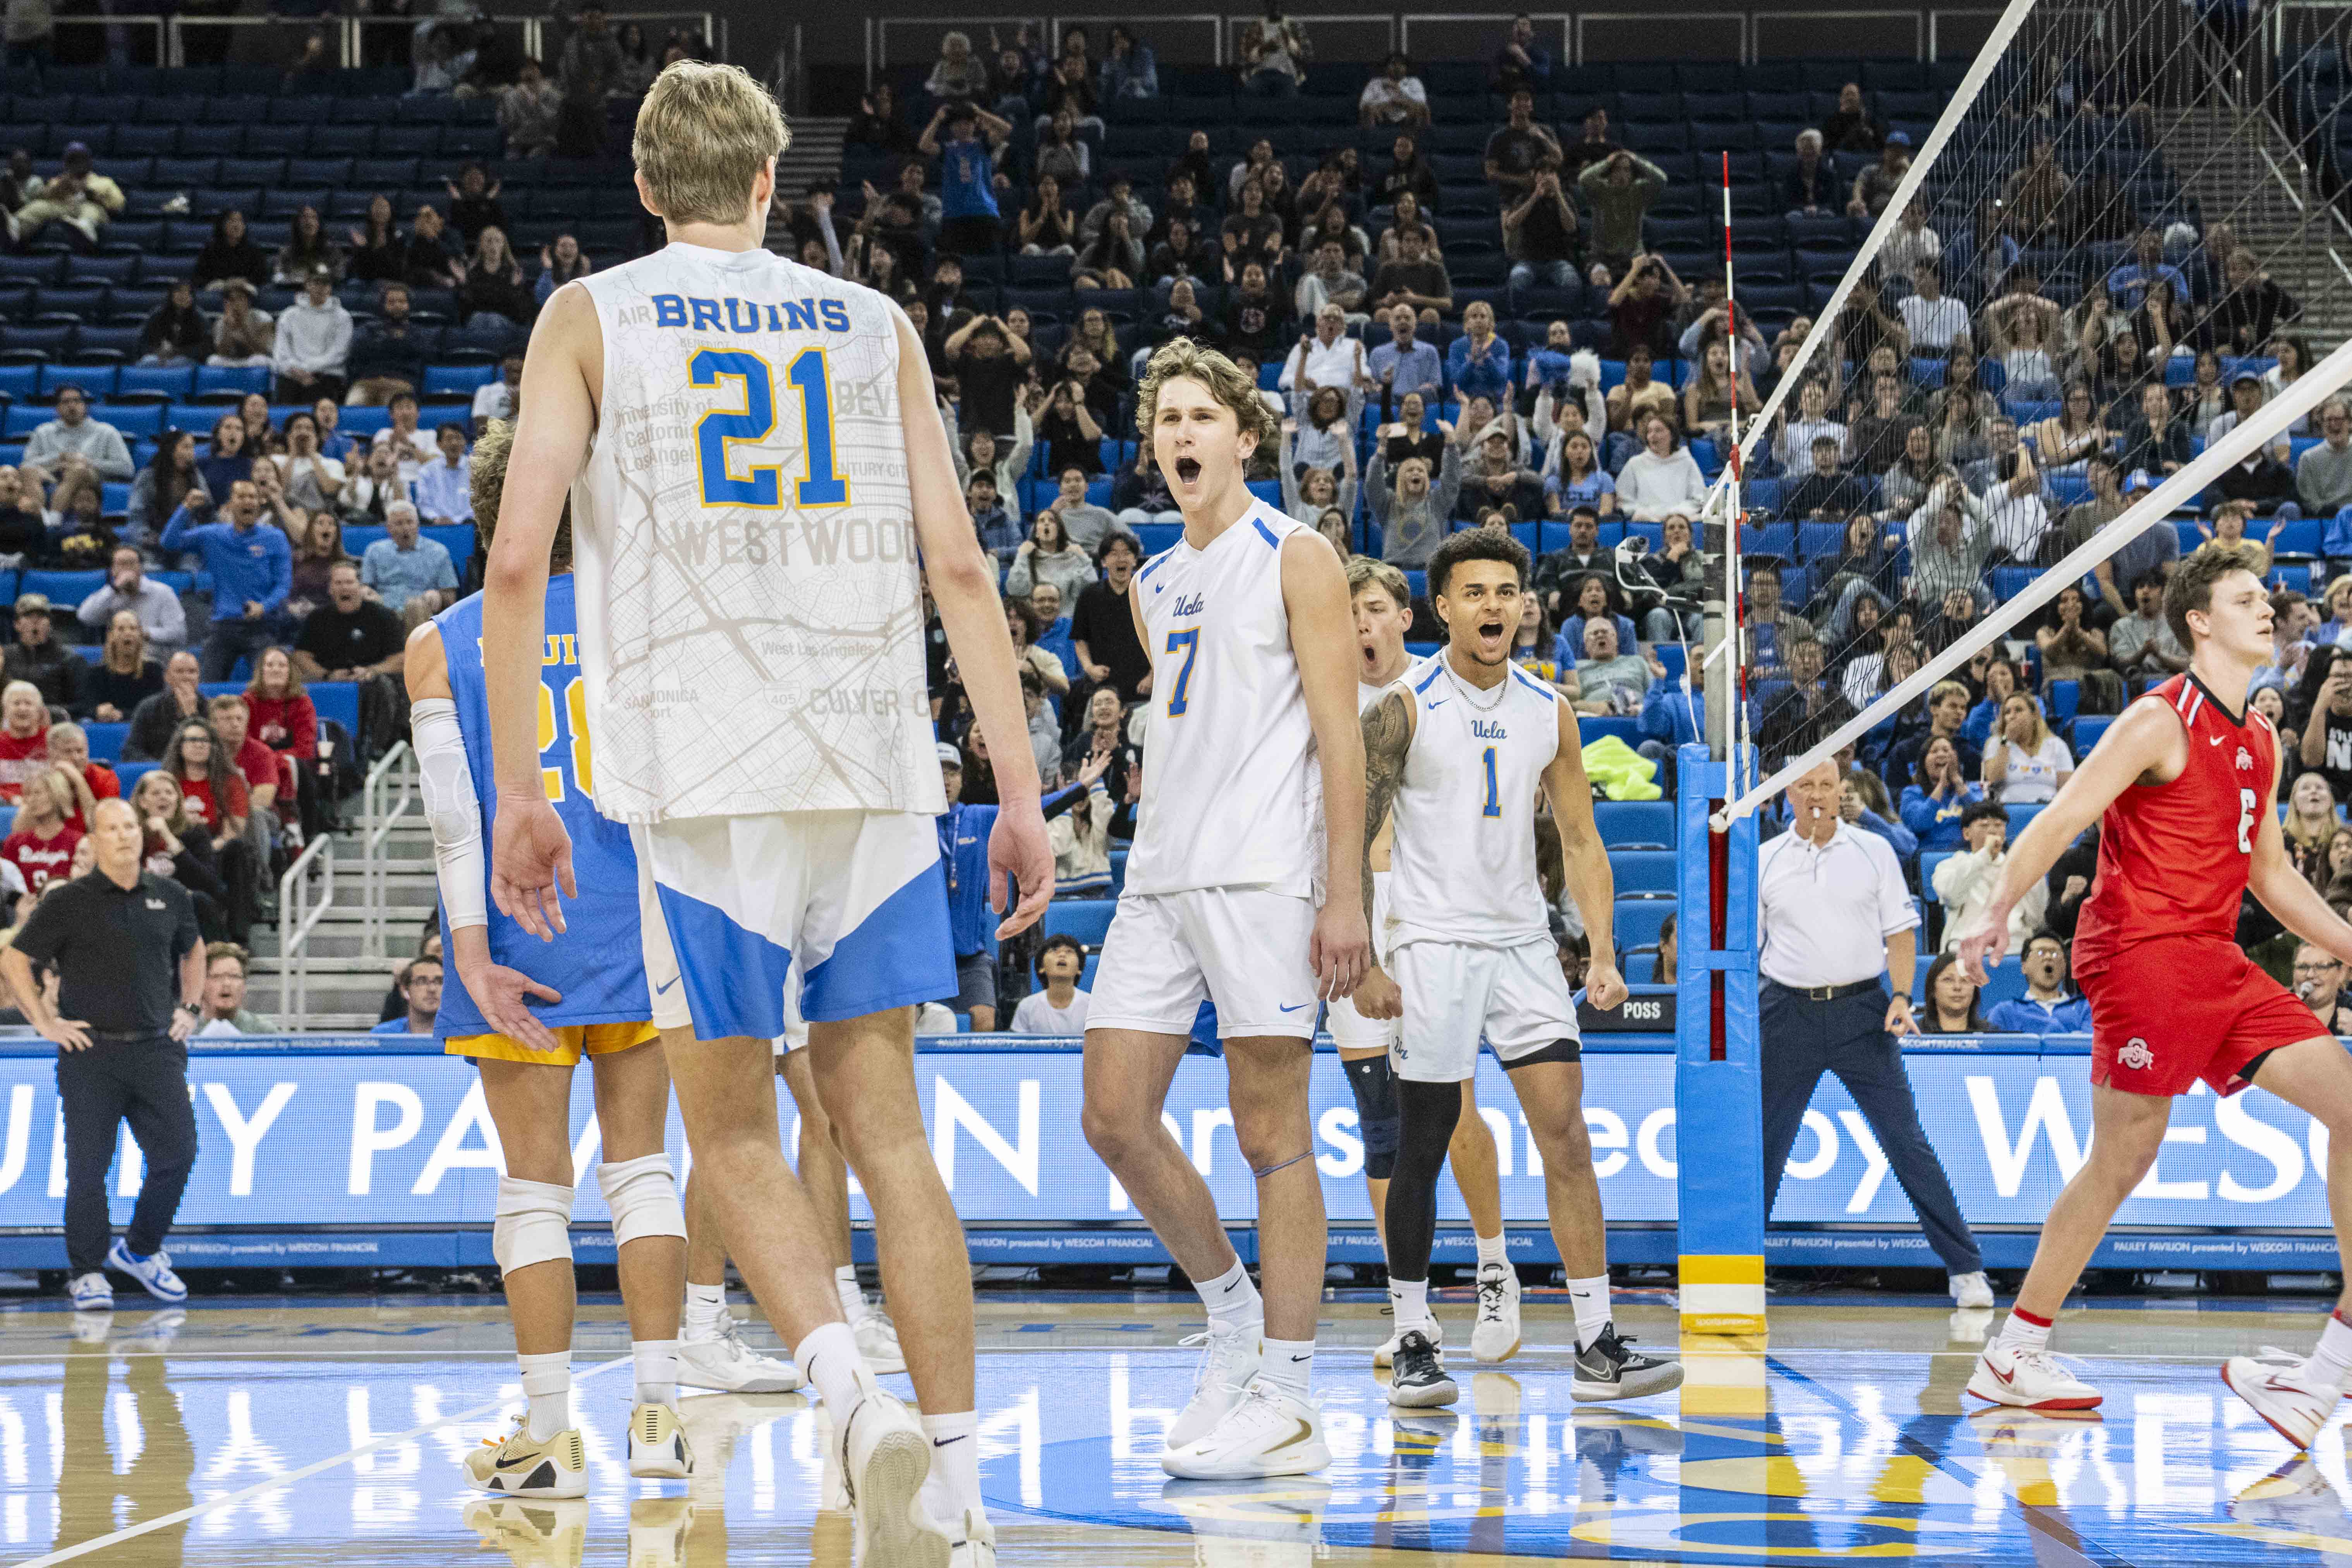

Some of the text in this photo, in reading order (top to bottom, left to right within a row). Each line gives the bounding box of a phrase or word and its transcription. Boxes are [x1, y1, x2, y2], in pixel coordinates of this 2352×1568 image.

[618, 306, 652, 328] AIR
[652, 293, 851, 333] BRUINS
[835, 380, 891, 417] BEV
[686, 346, 852, 510] 21
[1173, 592, 1204, 617] Ucla
[761, 641, 876, 659] West Los Angeles
[1164, 625, 1201, 718] 7
[770, 693, 797, 706] 405
[809, 688, 900, 717] CULVER
[1471, 720, 1507, 740] Ucla
[1481, 745, 1502, 818] 1
[1623, 1001, 1661, 1019] POSS
[1965, 1076, 2330, 1202] WES
[967, 1238, 1153, 1250] PAVILION presented by WESCOM FINANCIAL
[1444, 1237, 1475, 1247] WESCO
[1792, 1239, 1833, 1248] PAVILION
[1835, 1240, 1876, 1250] presented
[1878, 1239, 1890, 1251] by
[2114, 1242, 2339, 1254] PAULEY PAVILION presented by WESCOM FINANCIA
